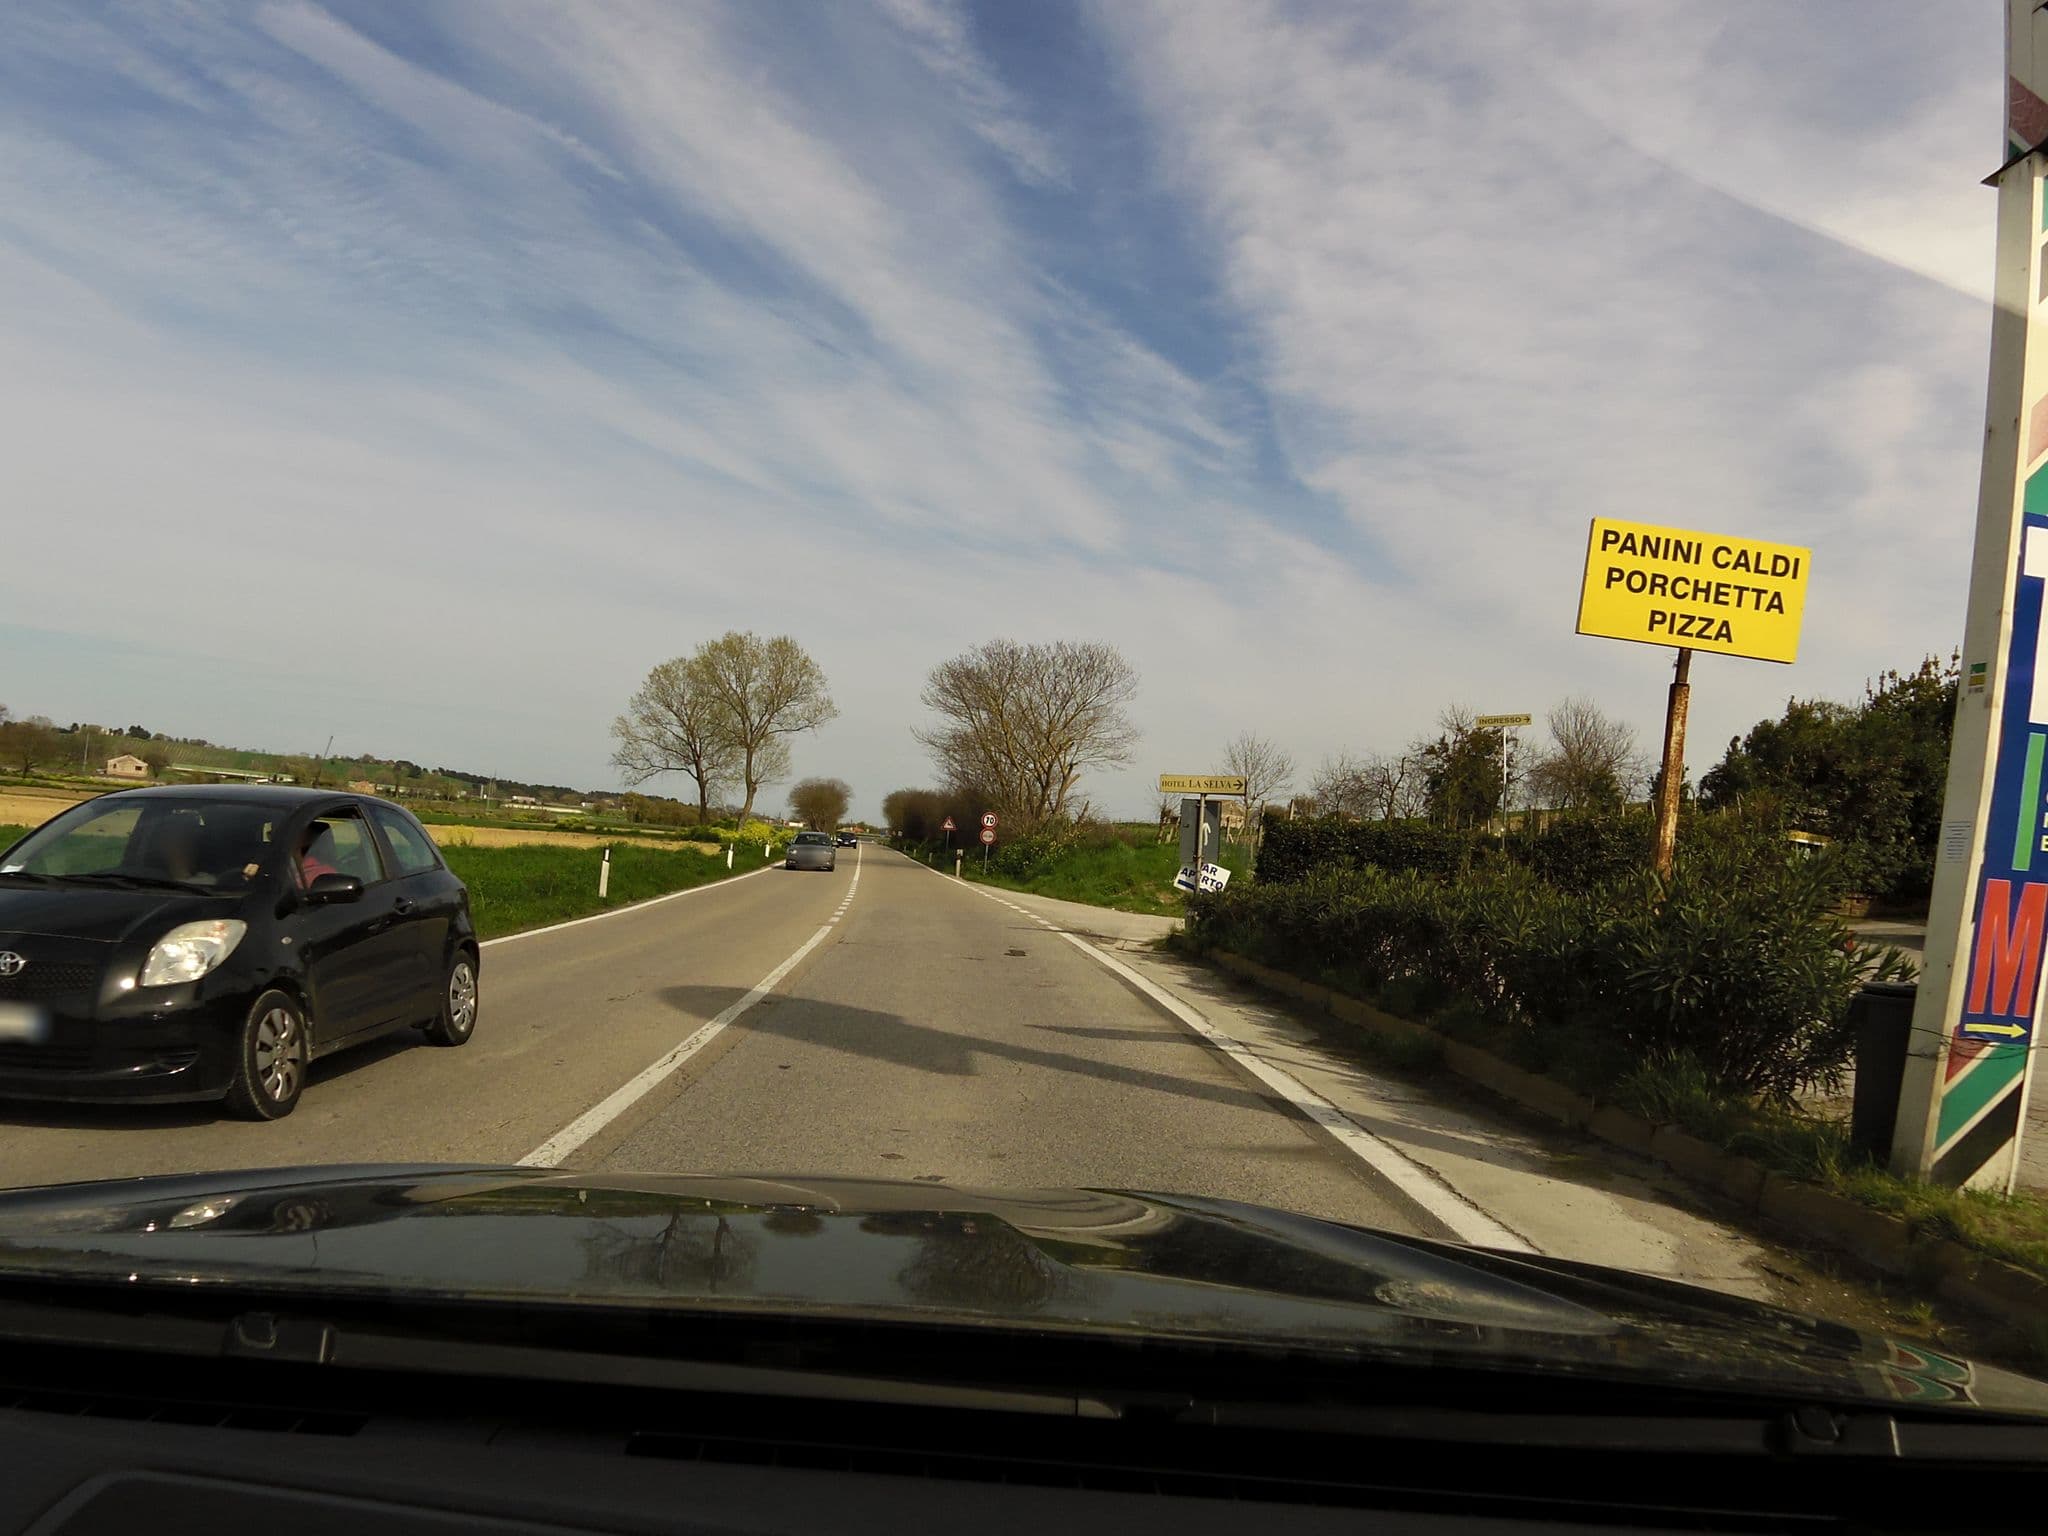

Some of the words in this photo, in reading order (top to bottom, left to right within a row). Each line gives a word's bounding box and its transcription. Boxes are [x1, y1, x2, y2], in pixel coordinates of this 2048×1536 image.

[1601, 529, 1702, 565] PANINI
[1711, 546, 1800, 580] CALDI
[1605, 567, 1785, 614] PORCHETTA
[1648, 609, 1733, 643] PIZZA
[1478, 716, 1522, 726] INGRESSO
[1161, 780, 1186, 788] HOTEL
[1188, 779, 1202, 788] LA
[1203, 780, 1232, 789] SELVA
[1180, 867, 1224, 890] APRTO
